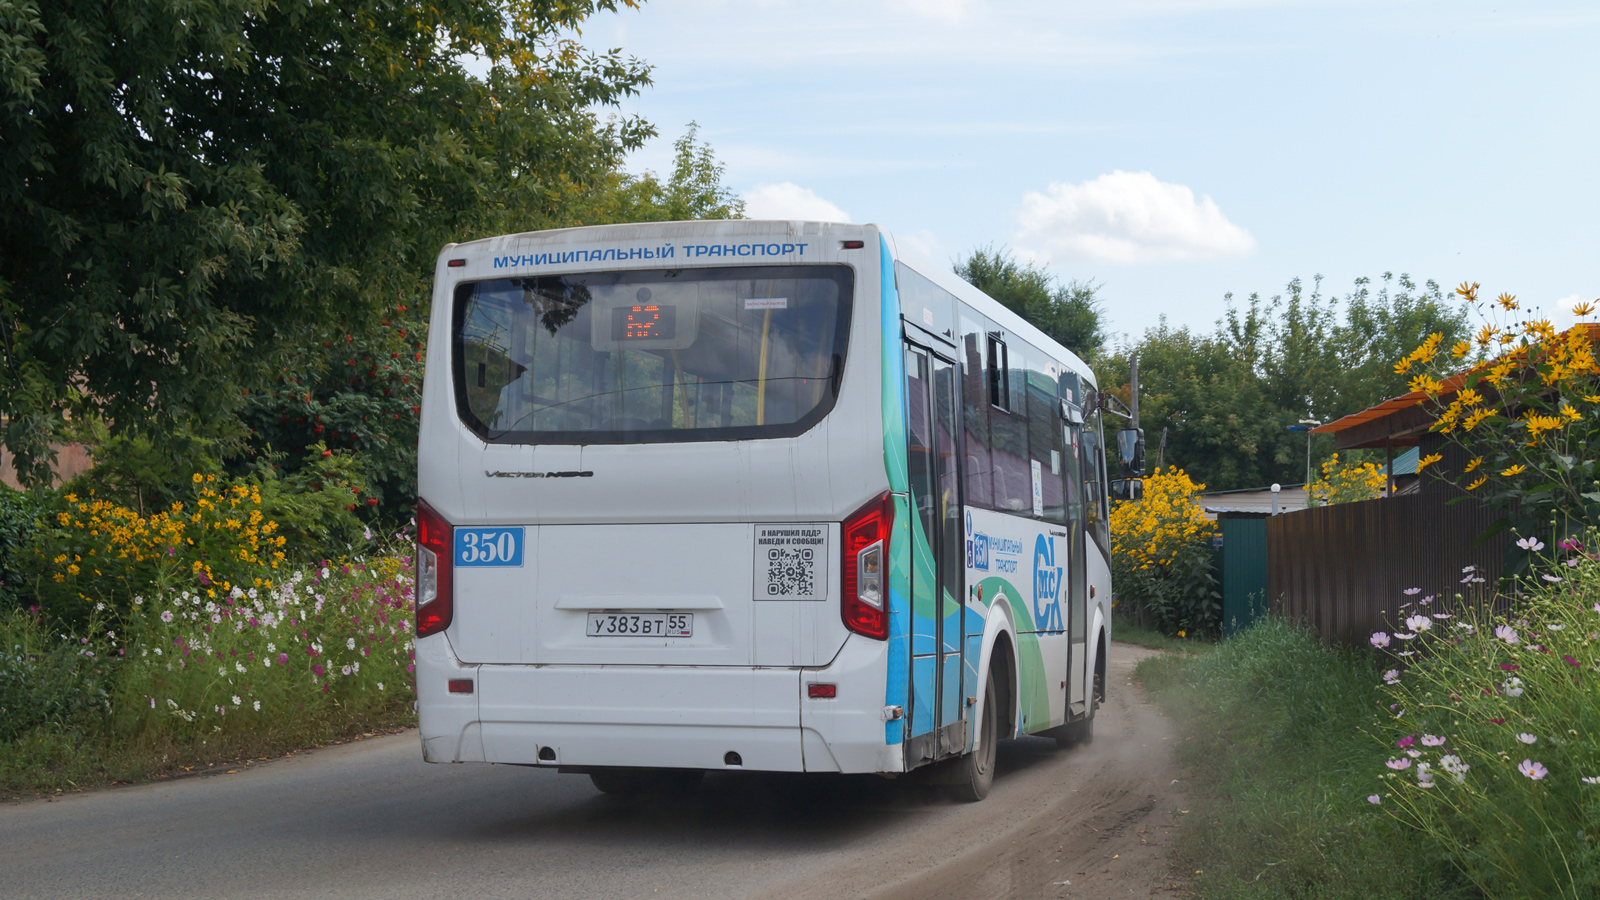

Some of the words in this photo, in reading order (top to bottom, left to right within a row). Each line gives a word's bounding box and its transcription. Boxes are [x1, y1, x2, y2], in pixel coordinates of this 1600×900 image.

[493, 242, 675, 269] МУНИЦИПАЛЬНЫЙ
[682, 243, 808, 258] ТРАНСПОРТ
[758, 538, 785, 546] НАВЕДИ
[801, 529, 821, 537] ПДД?
[461, 531, 516, 563] 350
[974, 540, 988, 566] 350
[988, 536, 1023, 554] МУНИЦИПАЛЬНЫЙ
[995, 558, 1018, 574] ТРАНСПОРТ
